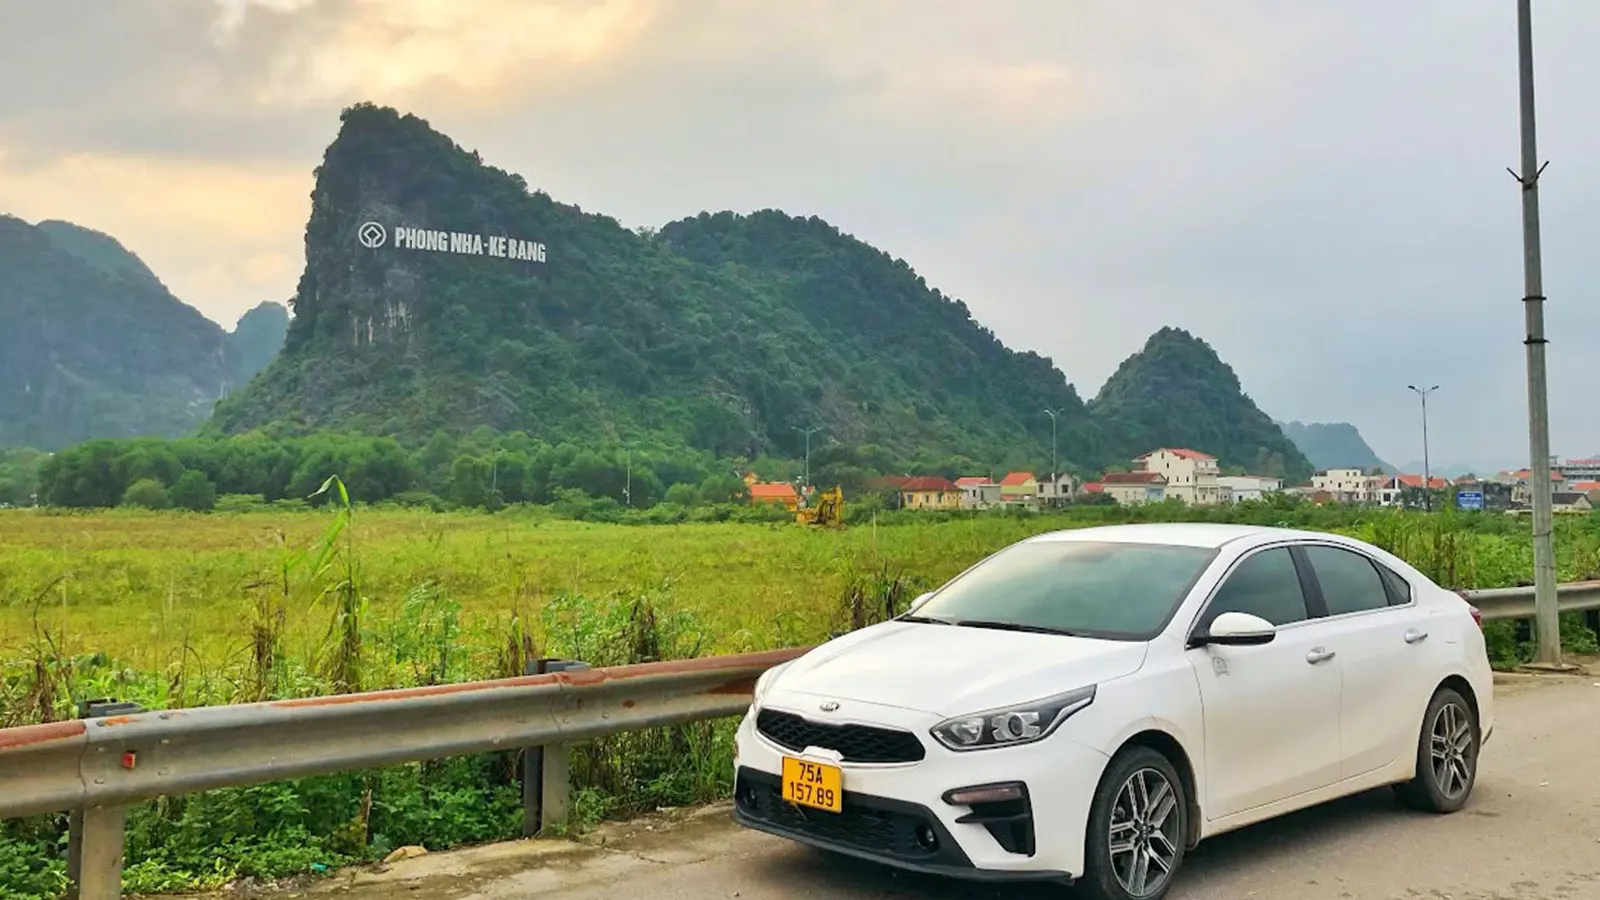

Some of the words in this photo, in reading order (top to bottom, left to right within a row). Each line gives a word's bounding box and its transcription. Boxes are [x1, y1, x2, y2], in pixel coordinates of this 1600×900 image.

[395, 226, 448, 252] PHONG
[508, 238, 546, 263] BANG
[799, 762, 822, 784] 75A
[790, 781, 834, 807] 157.89
